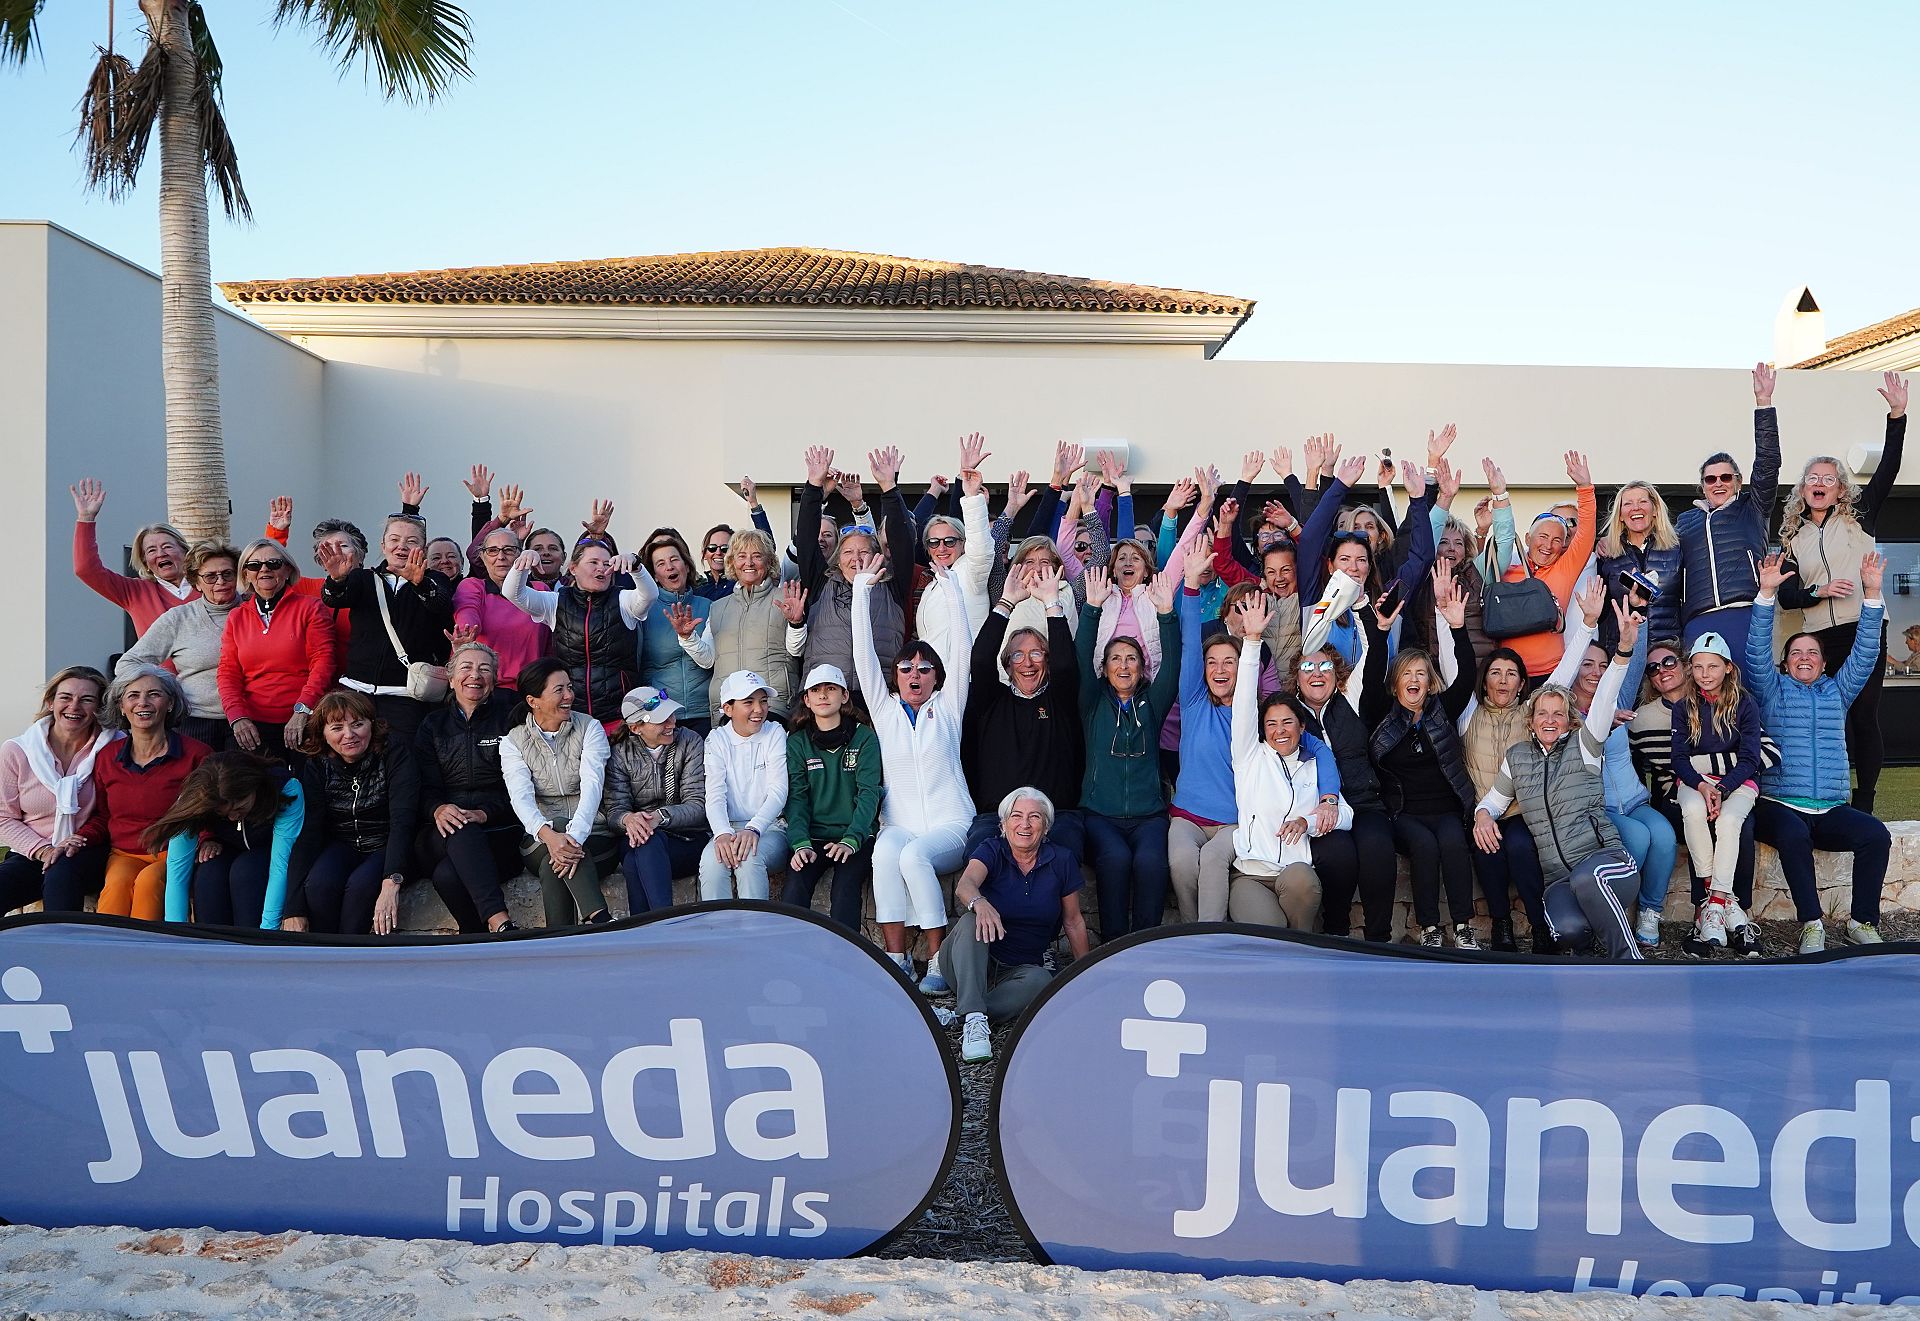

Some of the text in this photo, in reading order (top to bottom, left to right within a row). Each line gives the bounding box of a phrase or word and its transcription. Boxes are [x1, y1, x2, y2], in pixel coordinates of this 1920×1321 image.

[83, 1018, 830, 1183] juaneda
[1173, 1079, 1920, 1252] juaned
[446, 1175, 830, 1247] Hospitals
